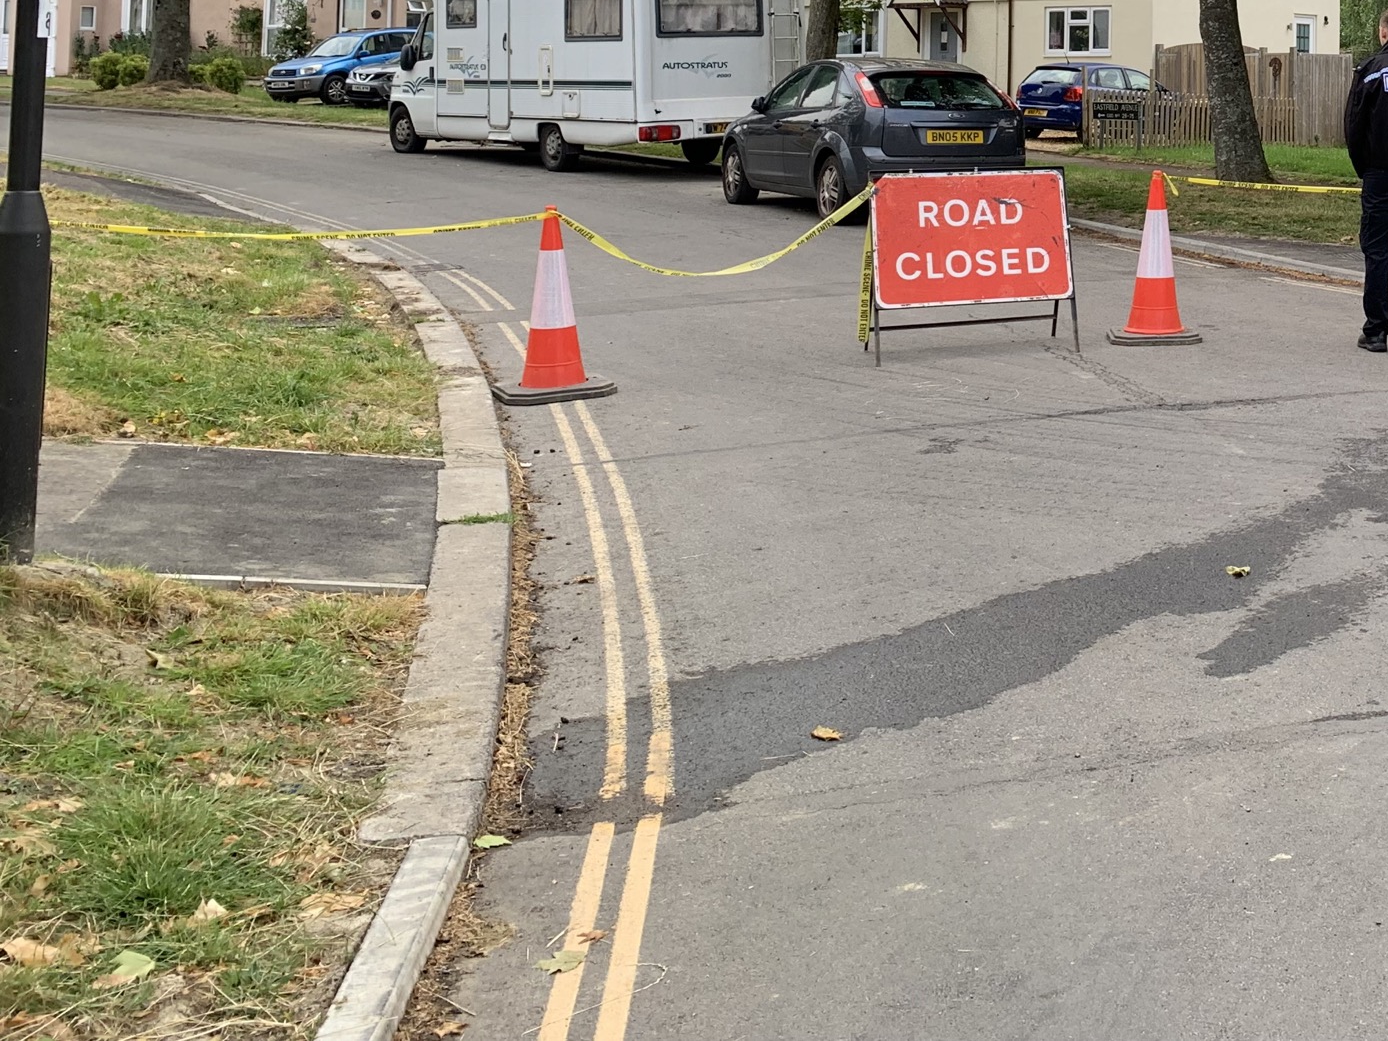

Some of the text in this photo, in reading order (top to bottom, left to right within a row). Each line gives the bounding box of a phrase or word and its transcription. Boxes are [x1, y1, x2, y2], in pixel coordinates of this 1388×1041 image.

[662, 61, 728, 70] AUTOSTRATUS
[931, 132, 980, 142] BN05 KKP
[918, 198, 1024, 227] ROAD
[864, 250, 873, 271] CRIME
[895, 246, 1051, 281] CLOSED
[861, 299, 869, 308] DO
[860, 309, 868, 320] NOT
